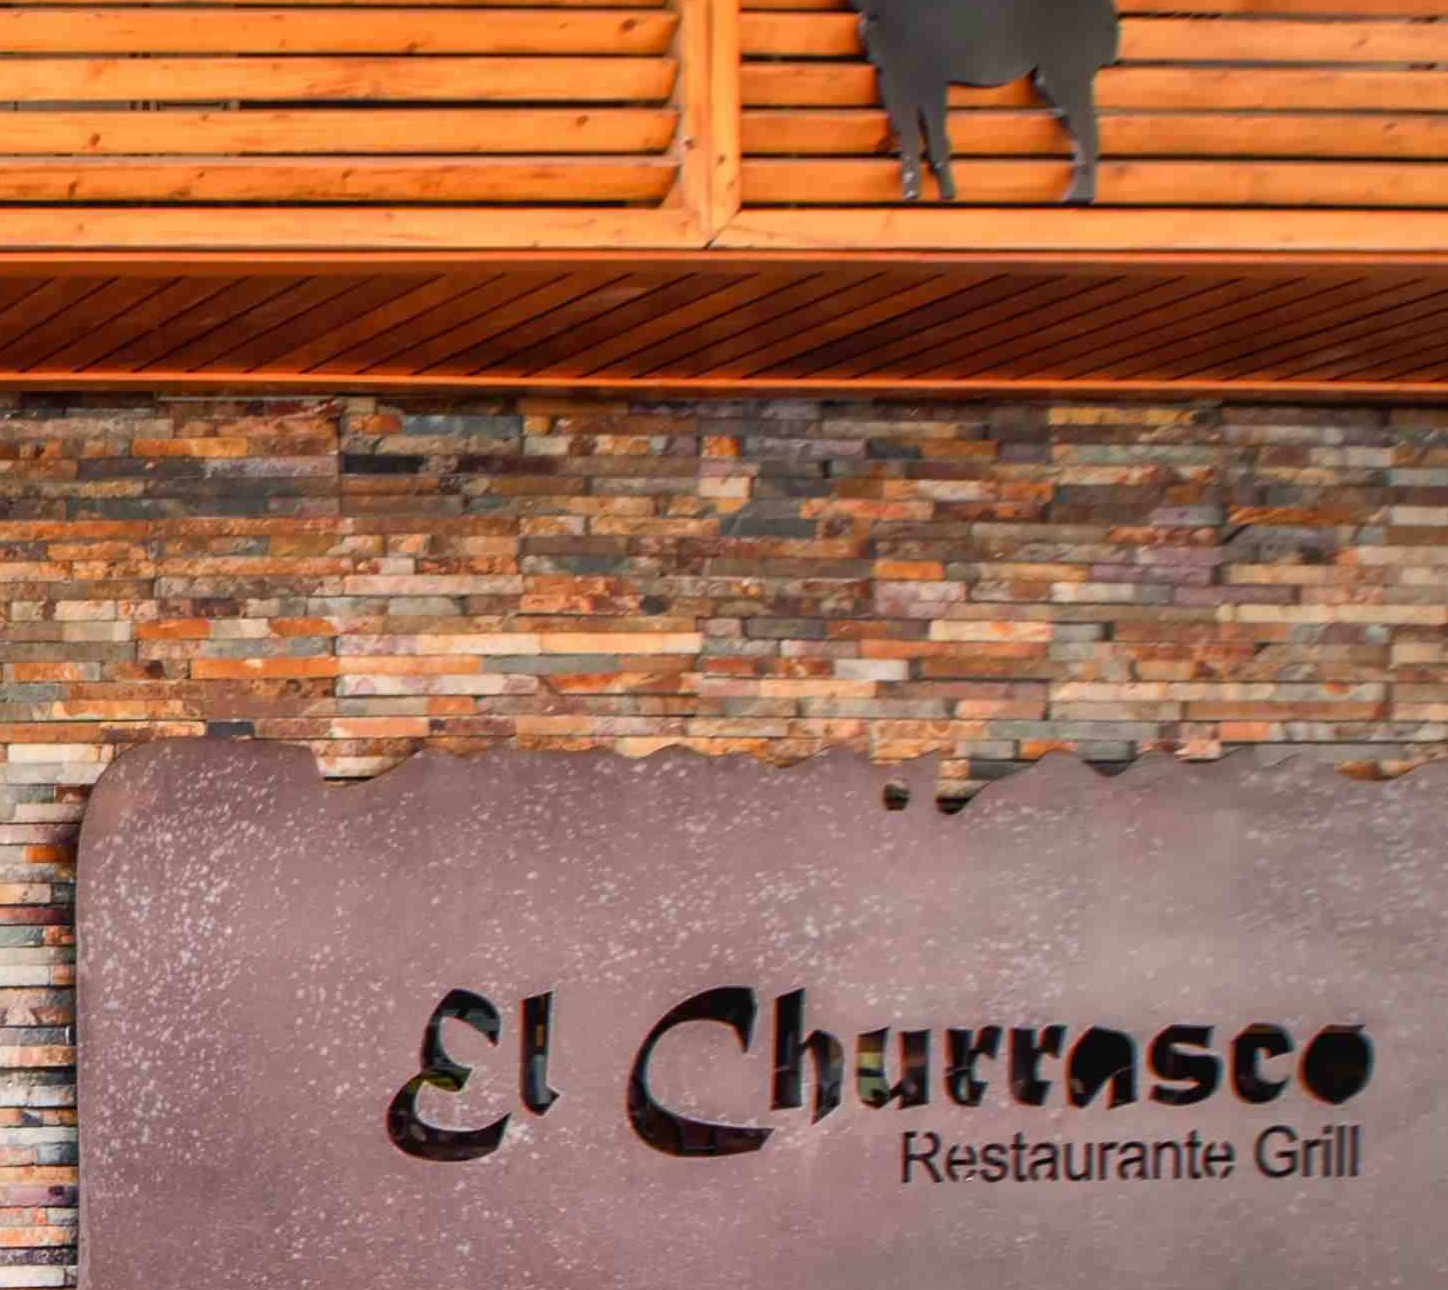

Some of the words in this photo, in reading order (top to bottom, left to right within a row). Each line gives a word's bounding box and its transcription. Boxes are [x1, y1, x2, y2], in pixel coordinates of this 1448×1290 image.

[385, 986, 558, 1162] El
[625, 983, 1376, 1158] Churrasco
[901, 1126, 1238, 1184] Restaurante
[1253, 1122, 1363, 1181] Grill
